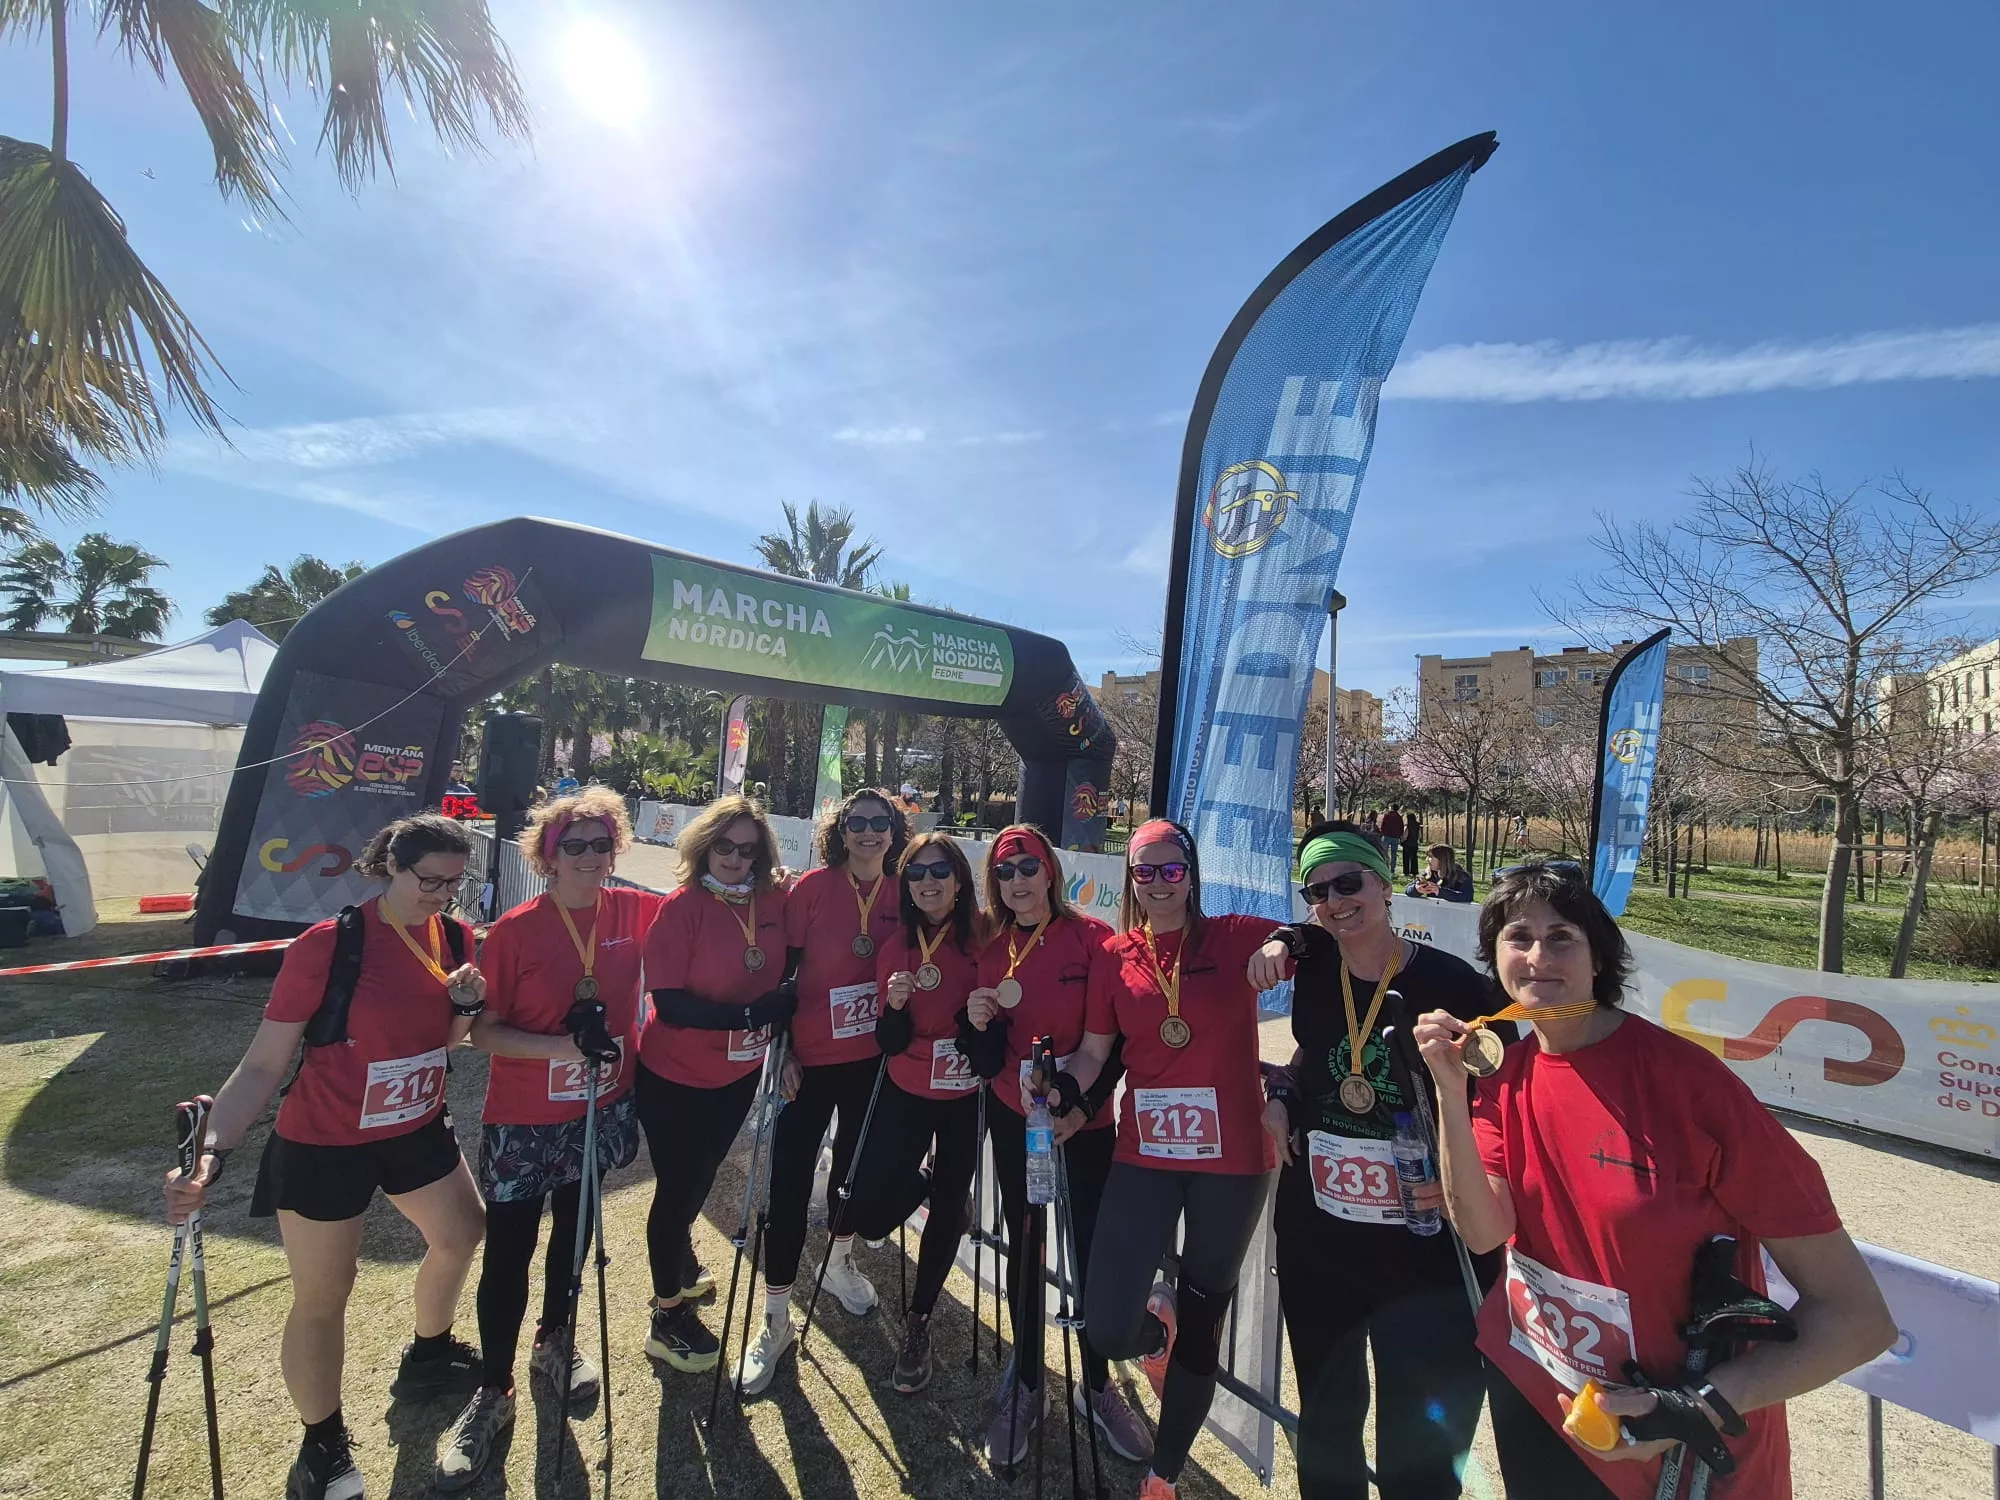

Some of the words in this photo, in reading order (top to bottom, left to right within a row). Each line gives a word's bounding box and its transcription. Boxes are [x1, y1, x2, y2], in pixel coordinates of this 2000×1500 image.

[672, 578, 832, 638] MARCHA
[668, 615, 788, 657] NÓRDICA
[932, 631, 1000, 656] MARCHA
[1198, 376, 1383, 896] FEDME
[933, 647, 1004, 672] NÓRDICA
[934, 667, 964, 680] FEDME
[363, 743, 424, 759] MONTAÑA
[843, 995, 878, 1022] 226
[1937, 1051, 2000, 1077] Con
[383, 1069, 435, 1106] 214
[1379, 1093, 1404, 1106] VIDA
[1937, 1092, 1972, 1112] de
[1150, 1109, 1204, 1137] 212
[1323, 1158, 1389, 1197] 233
[191, 1219, 204, 1260] LEKI
[1580, 1363, 1608, 1377] PEREZ
